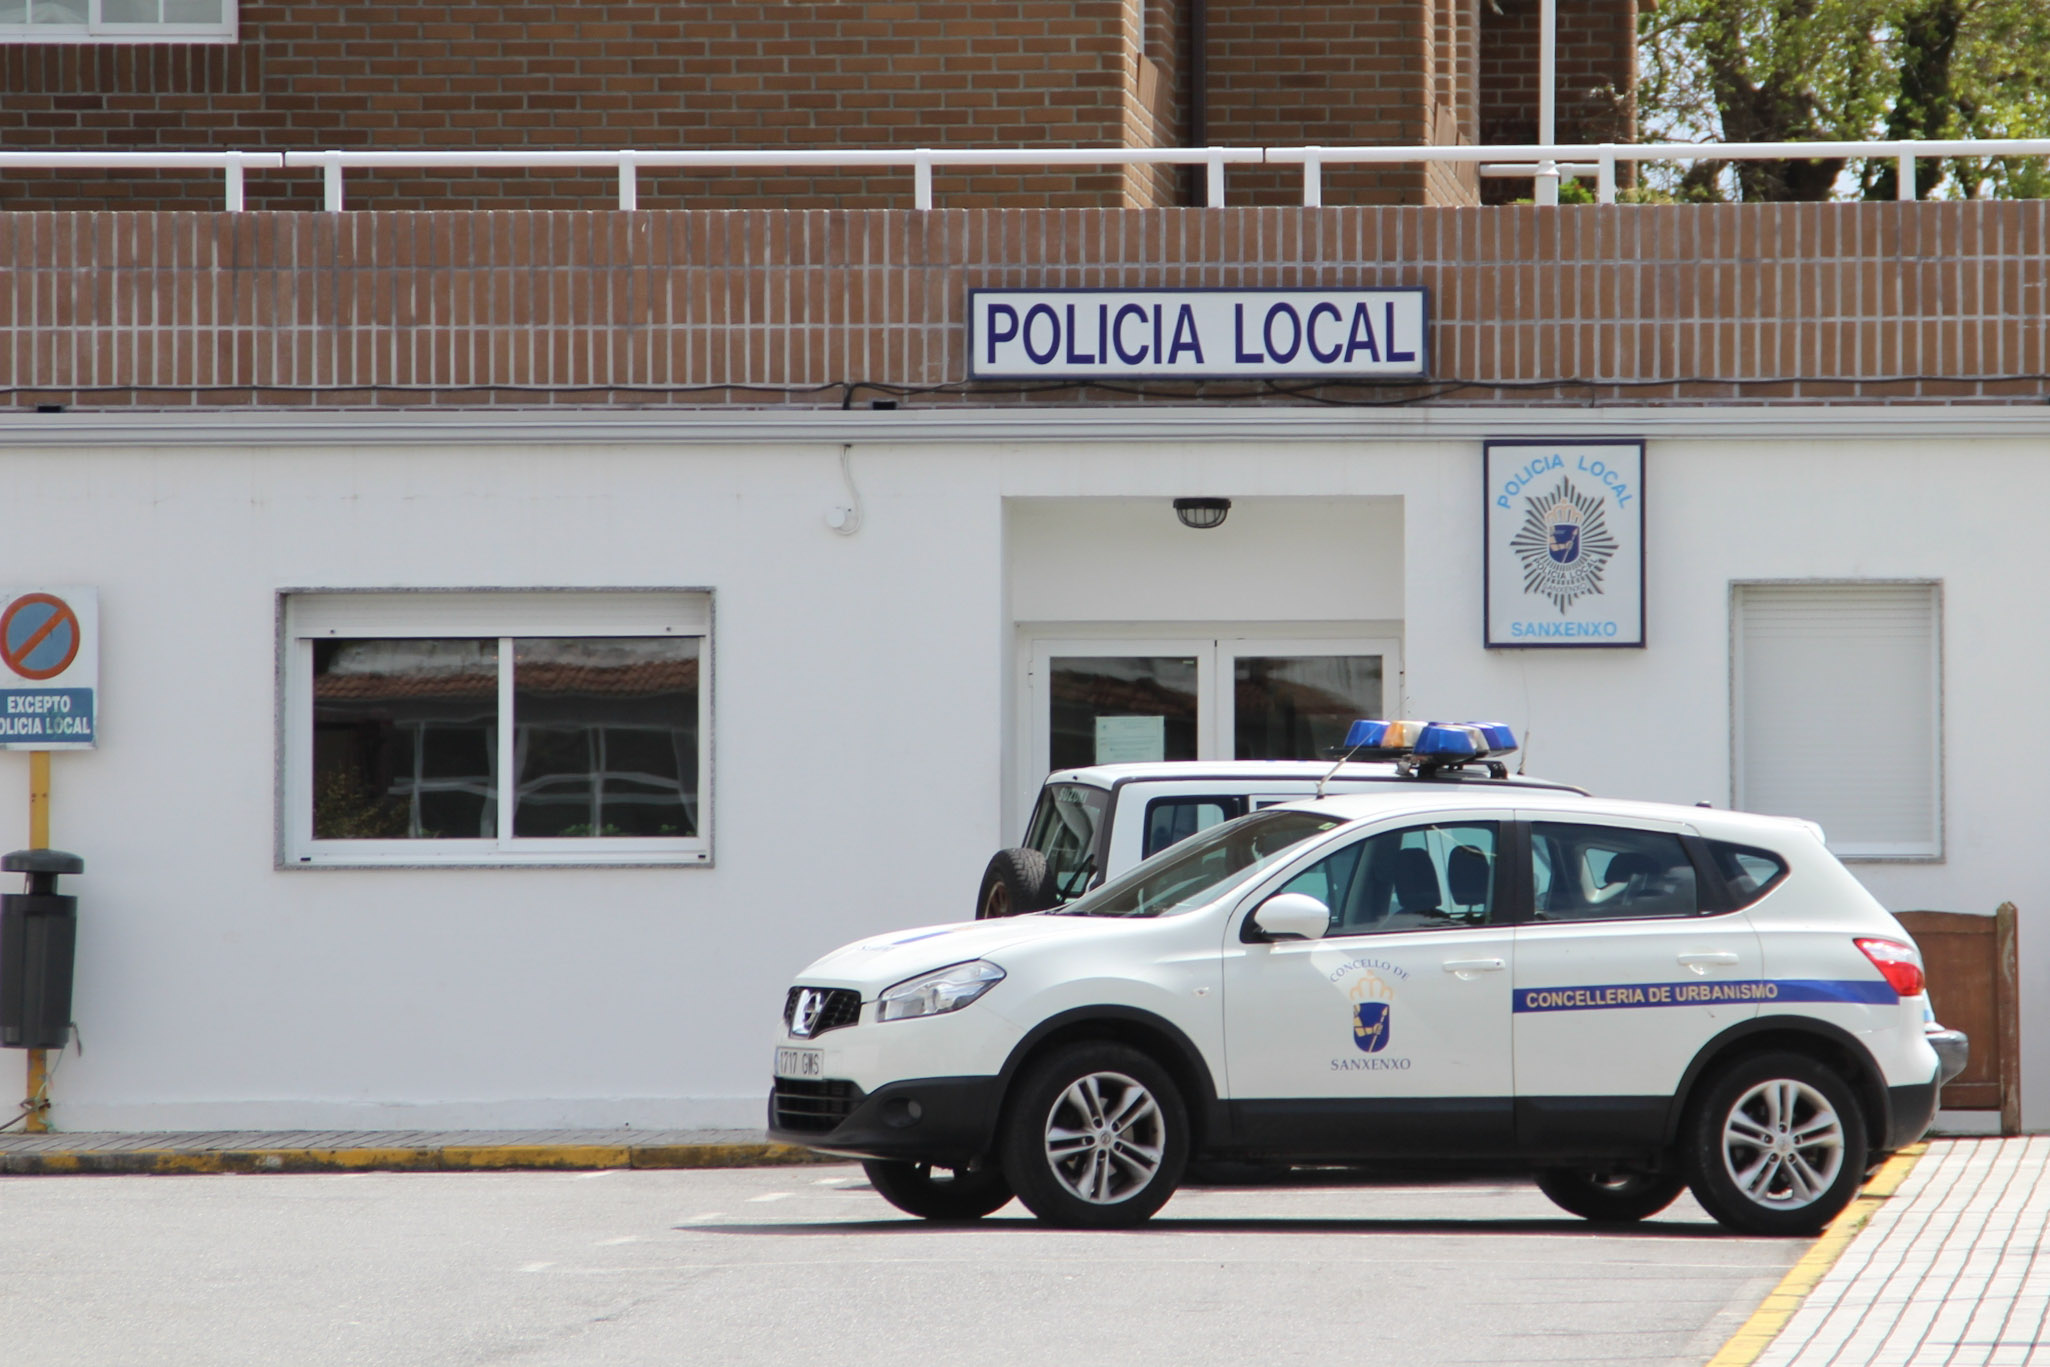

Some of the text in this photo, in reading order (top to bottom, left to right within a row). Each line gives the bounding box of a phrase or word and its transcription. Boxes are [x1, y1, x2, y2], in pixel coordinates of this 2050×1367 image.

[986, 302, 1415, 365] POLICIA LOCAL
[1497, 454, 1632, 509] POLICIA LOCAL
[1511, 621, 1617, 637] SANXENXO
[7, 695, 71, 713] EXCEPTO
[0, 716, 91, 735] OLICIA LOCAL
[1330, 959, 1410, 983] CONCELLO DE
[1526, 983, 1778, 1008] CONCELLERIA DE URBANISMO
[1330, 1058, 1411, 1071] SANXENXO
